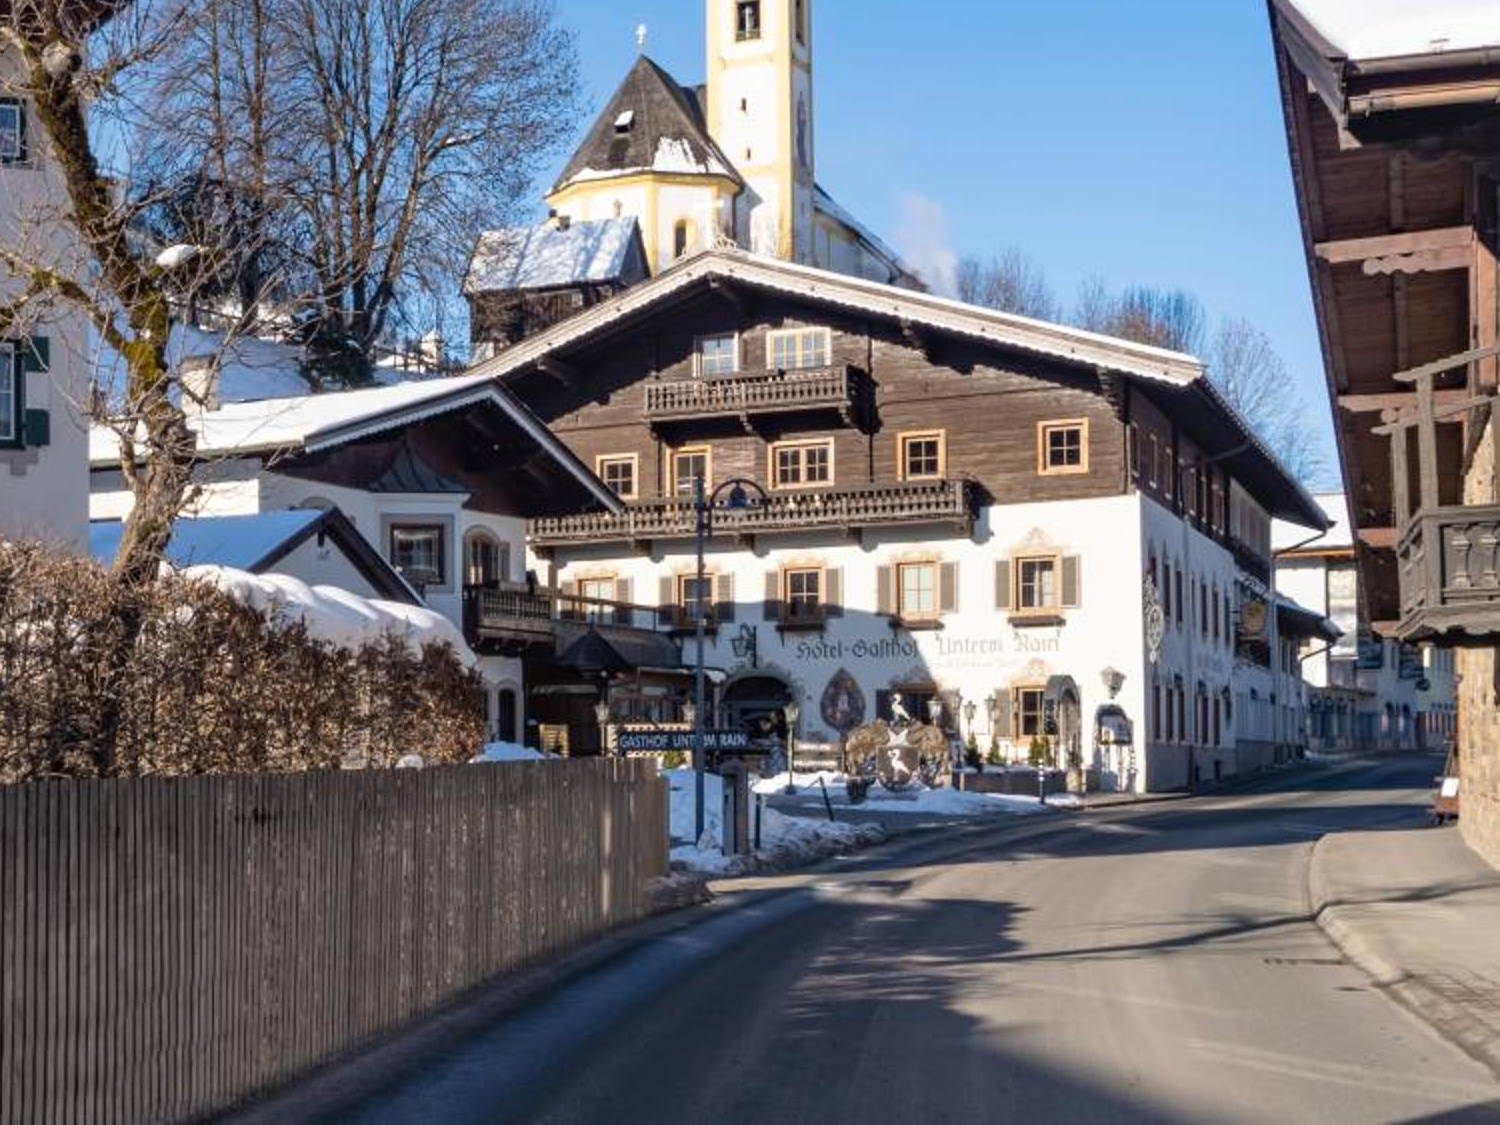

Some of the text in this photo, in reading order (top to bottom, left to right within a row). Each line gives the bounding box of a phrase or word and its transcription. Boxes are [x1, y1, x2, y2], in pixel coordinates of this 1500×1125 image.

[620, 733, 747, 748] GASTHOF UNTM RAIN
